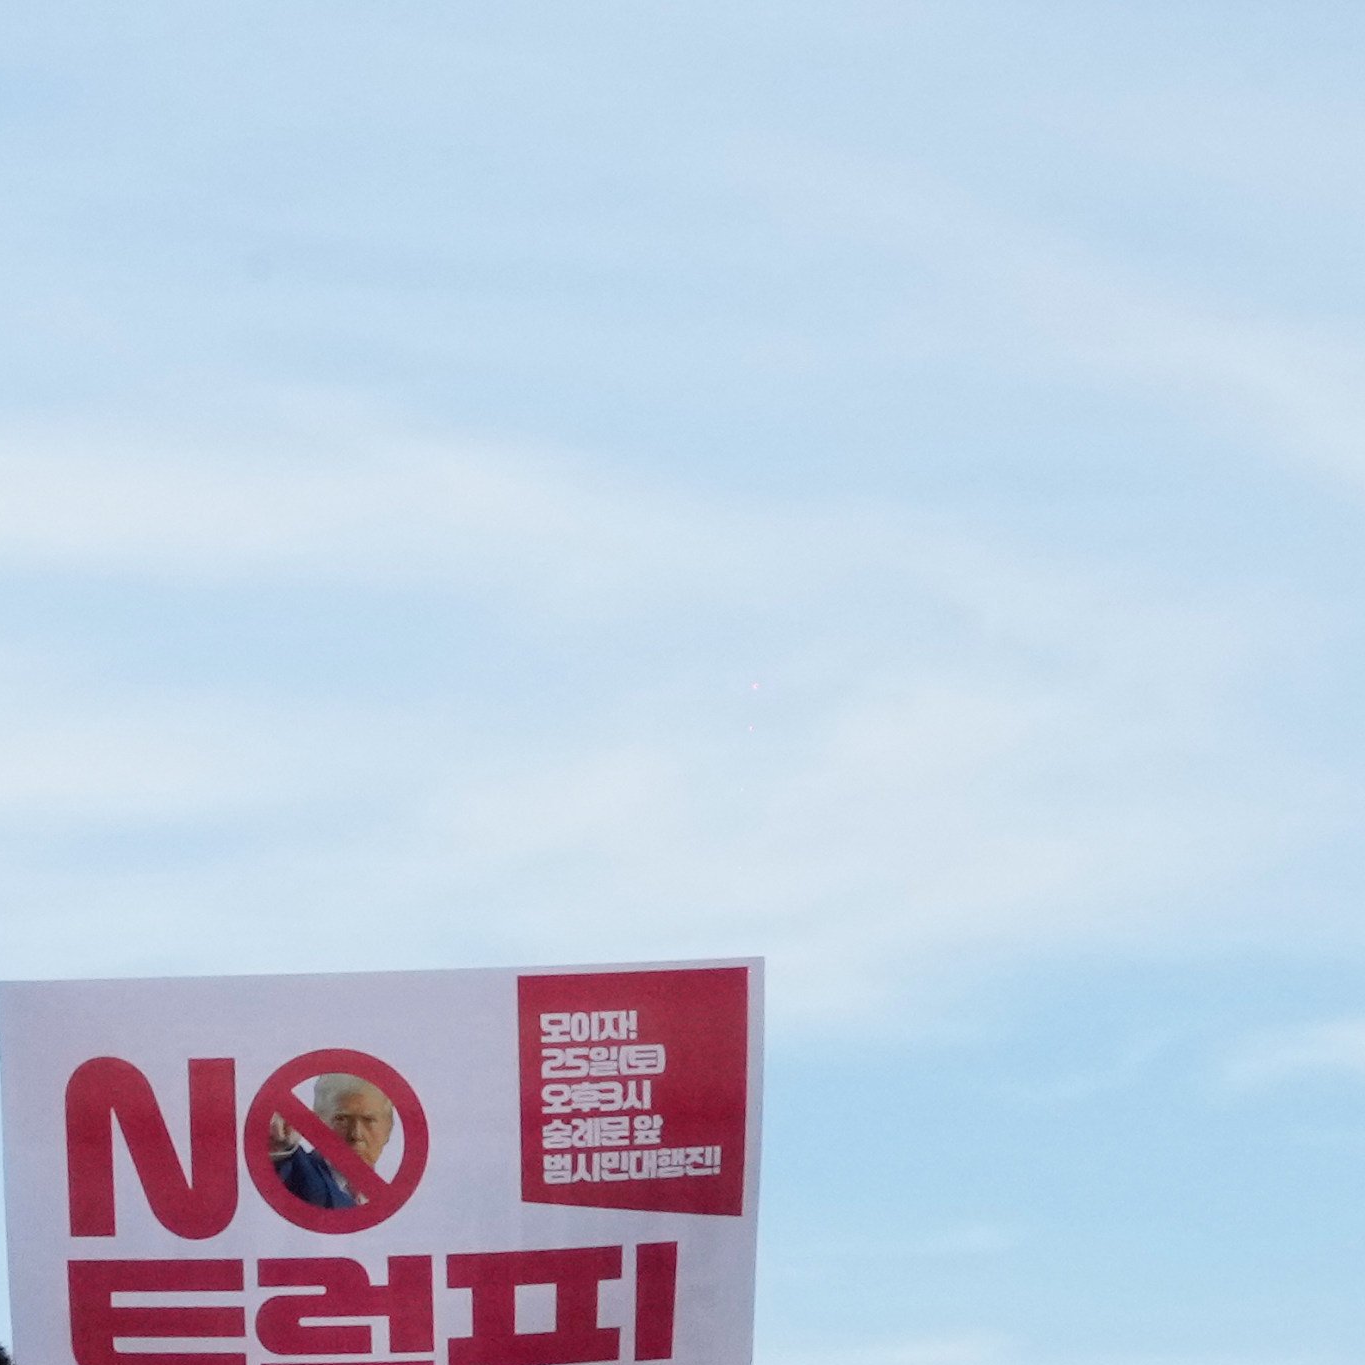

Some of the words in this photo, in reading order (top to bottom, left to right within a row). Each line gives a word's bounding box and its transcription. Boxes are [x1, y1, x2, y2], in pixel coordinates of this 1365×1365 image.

[540, 1010, 638, 1043] 모이자!
[541, 1044, 666, 1078] 25일(토)
[65, 1048, 429, 1240] NO
[542, 1116, 630, 1149] 숭례문
[631, 1115, 664, 1145] 앞
[543, 1146, 722, 1184] 범시민대행진!
